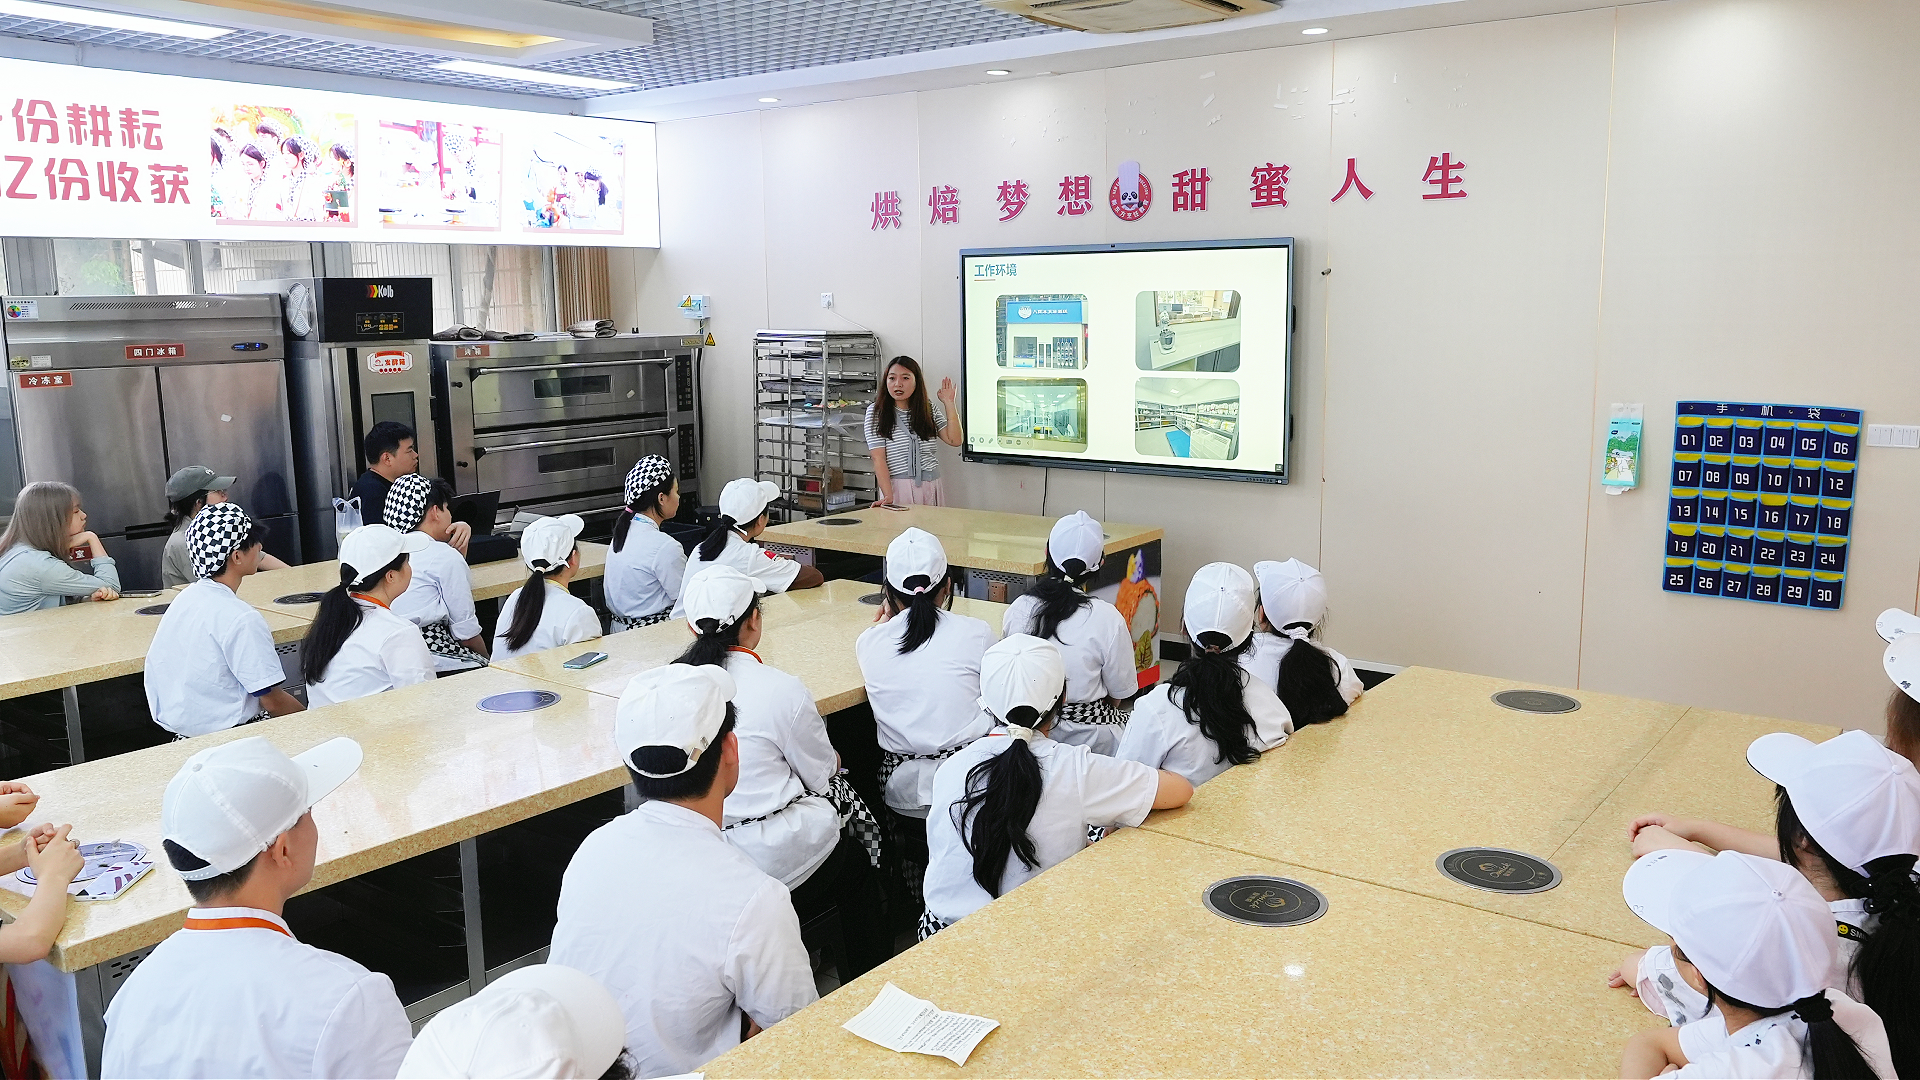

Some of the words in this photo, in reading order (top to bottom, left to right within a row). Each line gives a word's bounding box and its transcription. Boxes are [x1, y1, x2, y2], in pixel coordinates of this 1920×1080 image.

[0, 98, 163, 150] 份耕耘
[870, 174, 1092, 231] 烘焙梦想
[1171, 151, 1469, 213] 甜蜜人生
[974, 263, 1018, 277] 工作环境
[378, 285, 394, 298] Kolb
[133, 347, 177, 357] 四门冰箱
[28, 375, 63, 385] 冷冻室
[1716, 403, 1821, 419] 手机袋
[1682, 434, 1696, 446] 01
[1710, 435, 1724, 447] 02
[1740, 435, 1754, 448] 03
[1771, 436, 1785, 450] 04
[1802, 437, 1817, 451] 05
[1834, 441, 1849, 455] 06
[1679, 469, 1693, 482] 07
[1706, 470, 1720, 483] 08
[1736, 472, 1750, 485] 09
[1768, 473, 1782, 487] 10
[1798, 475, 1811, 488] 11
[1830, 477, 1844, 491] 12
[1677, 505, 1691, 517] 13
[1706, 505, 1719, 519] 14
[1735, 507, 1748, 520] 15
[1765, 510, 1779, 524] 16
[1796, 512, 1810, 526] 17
[1828, 515, 1842, 529] 18
[1675, 540, 1688, 553] 19
[1702, 541, 1716, 555] 20
[1731, 544, 1743, 558] 21
[1761, 547, 1776, 560] 22
[1791, 549, 1806, 562] 23
[1821, 552, 1836, 565] 24
[1670, 574, 1684, 586] 25
[1699, 576, 1714, 589] 26
[1727, 579, 1742, 593] 27
[1757, 583, 1771, 596] 28
[1788, 585, 1803, 599] 29
[1818, 588, 1832, 602] 30
